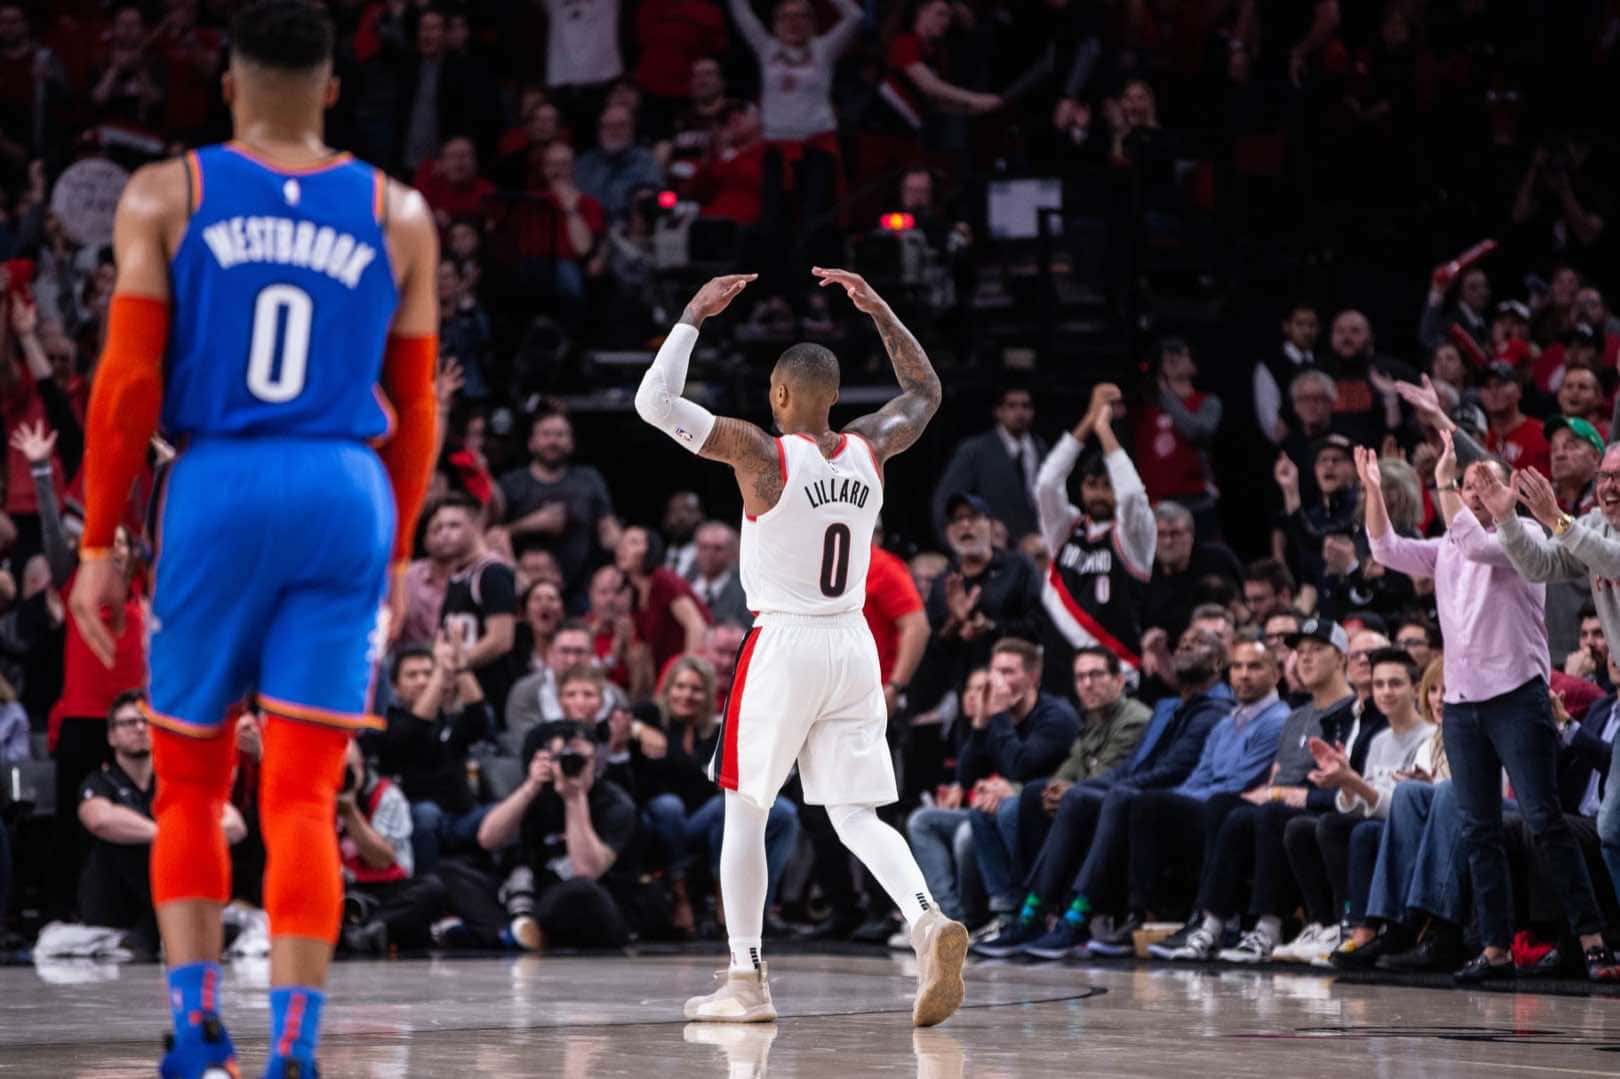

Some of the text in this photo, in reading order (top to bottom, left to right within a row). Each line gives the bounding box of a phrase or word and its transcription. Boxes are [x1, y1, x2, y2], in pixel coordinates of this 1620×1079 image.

[203, 216, 376, 288] WESTBROOK
[246, 283, 313, 403] 0
[804, 478, 870, 509] LILLARD
[820, 522, 851, 598] 0
